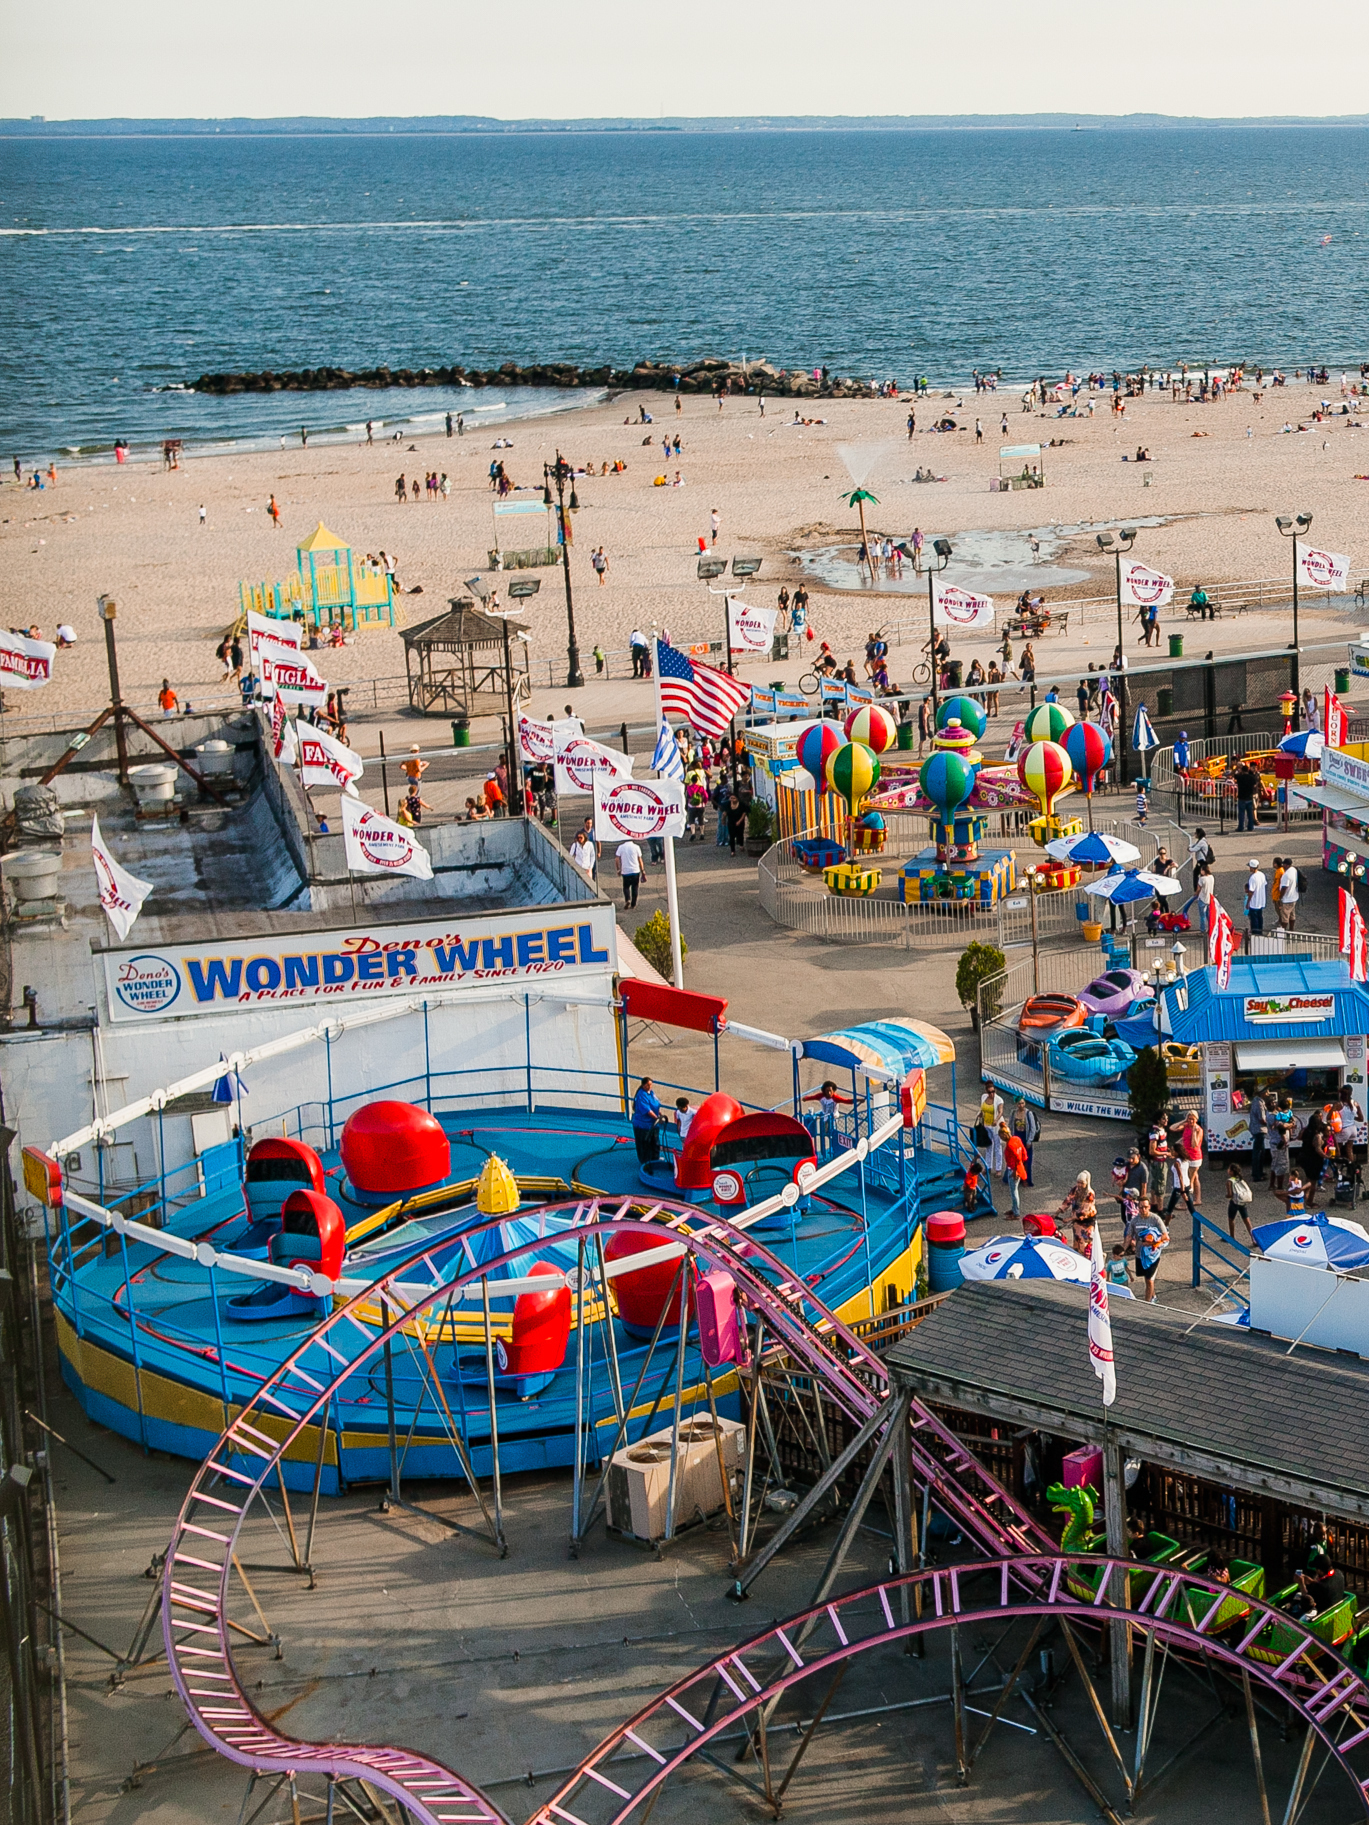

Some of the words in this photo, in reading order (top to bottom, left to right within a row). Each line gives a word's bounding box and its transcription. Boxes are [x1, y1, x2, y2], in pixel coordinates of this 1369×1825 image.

[938, 597, 962, 607] WONDER
[735, 620, 761, 629] WONDER
[557, 755, 596, 766] WONDER
[601, 802, 643, 814] WONDER
[648, 804, 680, 815] WHEEL
[352, 828, 394, 842] WONDER
[340, 933, 462, 956] Deno's
[181, 947, 418, 1003] WONDER
[430, 921, 610, 973] WHEEL
[118, 963, 169, 982] Deno's
[122, 979, 173, 992] WONDER
[238, 992, 251, 1002] A
[257, 986, 308, 1000] PLACE
[314, 984, 345, 994] FOR
[351, 980, 385, 992] FUN
[390, 977, 404, 988] &
[409, 972, 467, 986] FAMILY
[473, 968, 519, 979] SINCE
[525, 961, 565, 973] 1920
[129, 990, 169, 1000] WHEEL
[1246, 1000, 1268, 1013] Say
[1288, 996, 1334, 1009] Cheese!
[1067, 1102, 1093, 1112] WILLIE
[1096, 1106, 1111, 1115] THE
[1114, 1108, 1133, 1117] WHA
[839, 1134, 852, 1147] EXIT
